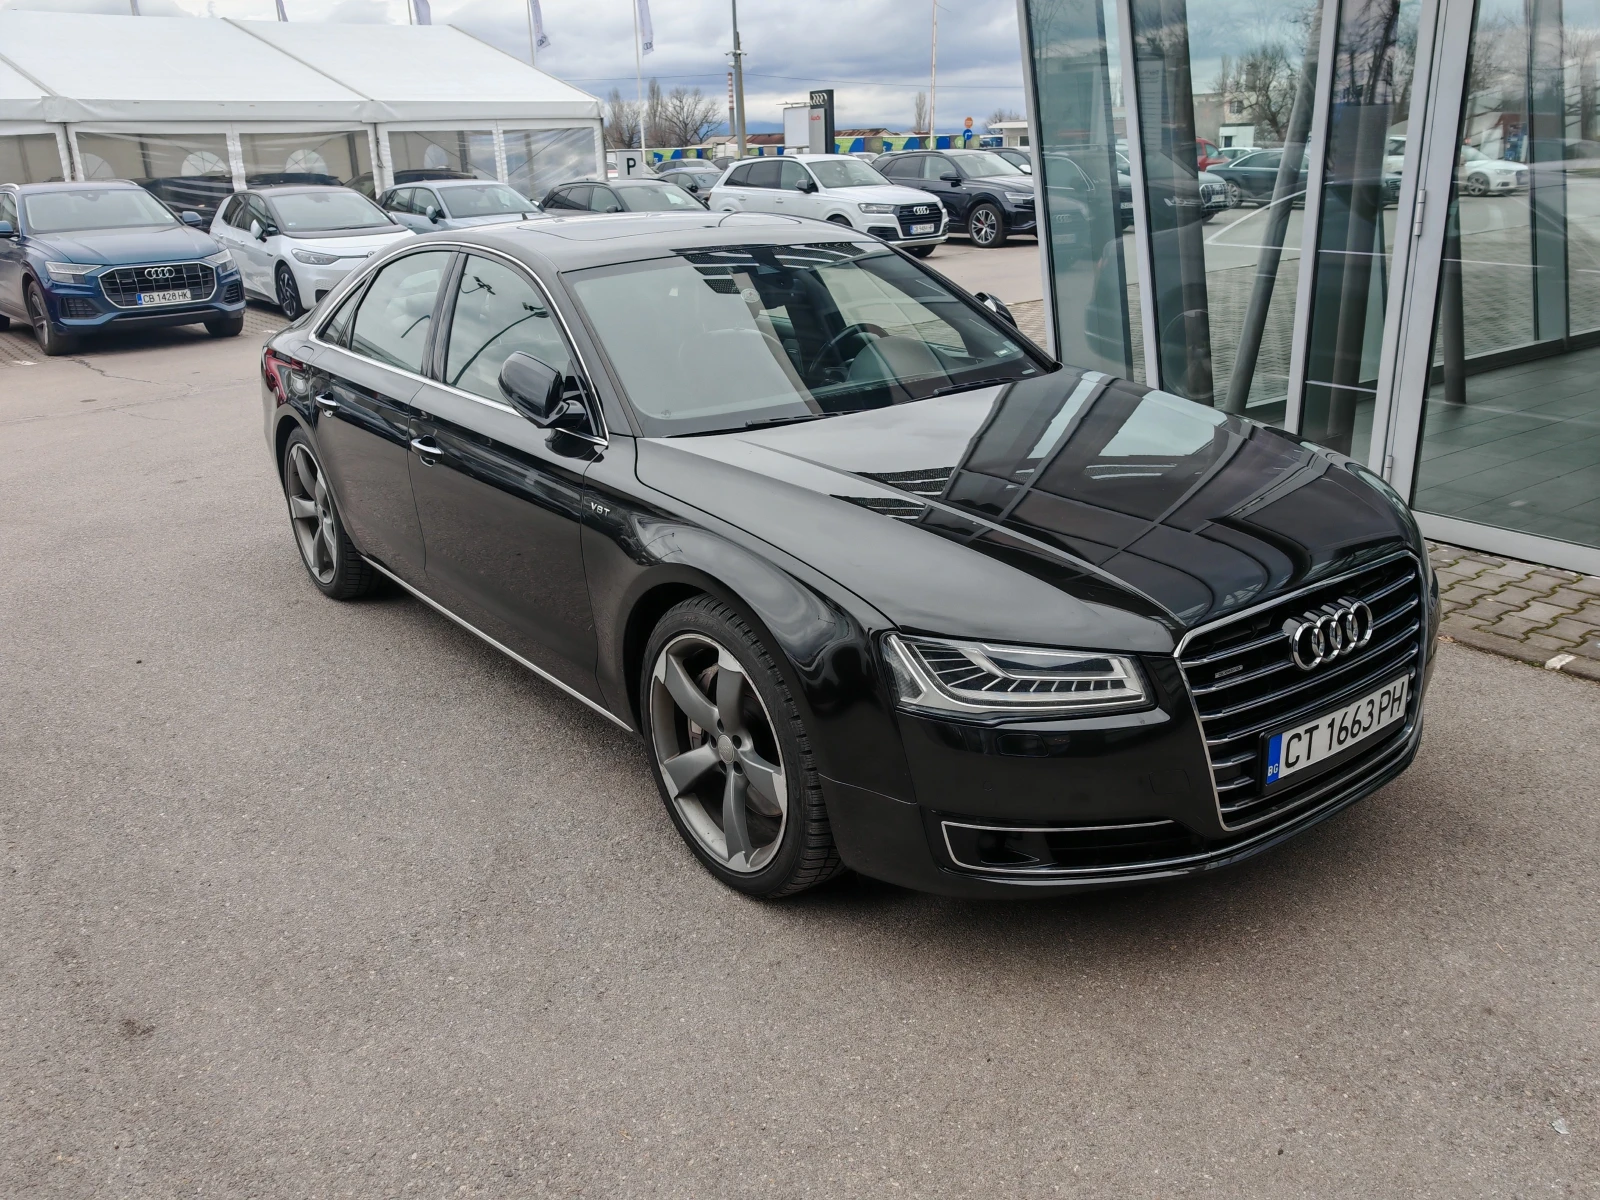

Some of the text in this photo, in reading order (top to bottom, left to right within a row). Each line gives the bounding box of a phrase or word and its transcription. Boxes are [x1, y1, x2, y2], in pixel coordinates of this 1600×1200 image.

[626, 157, 636, 175] P
[143, 294, 155, 303] CB
[156, 292, 177, 302] 1428
[591, 501, 610, 517] V8T
[1284, 681, 1405, 769] CT 1663 PH
[1267, 763, 1279, 776] BG
